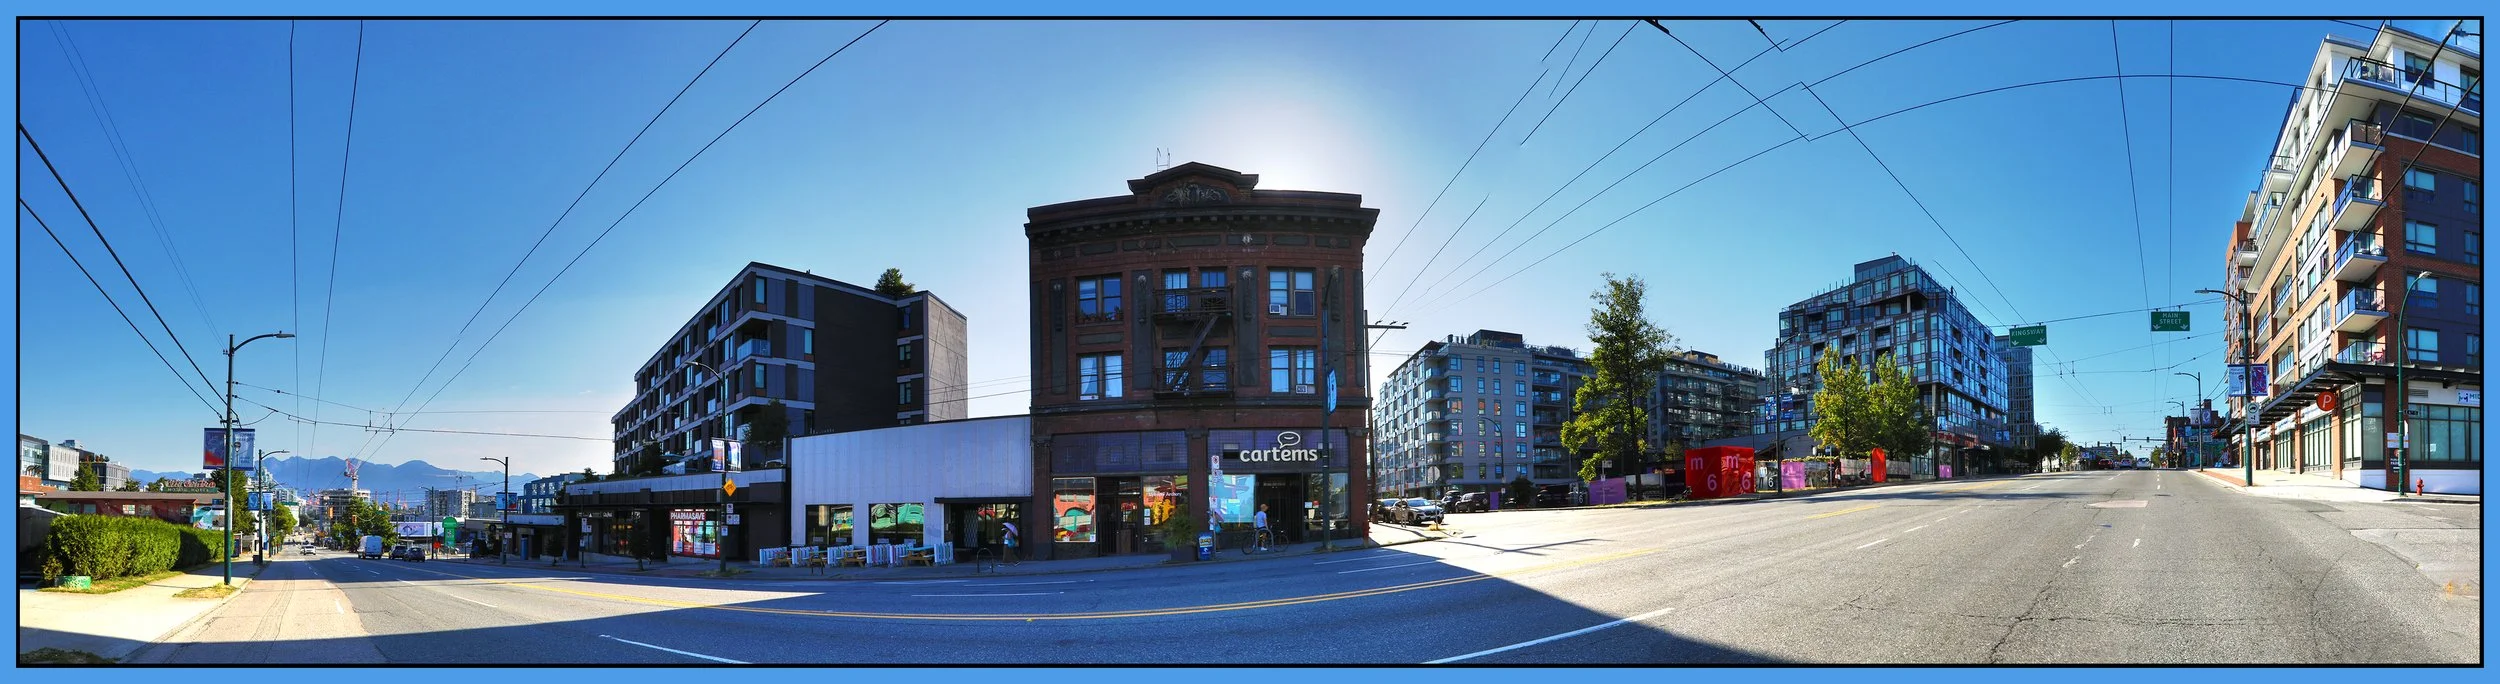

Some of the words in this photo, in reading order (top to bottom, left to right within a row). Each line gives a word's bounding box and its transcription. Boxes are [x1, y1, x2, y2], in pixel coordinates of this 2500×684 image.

[2322, 394, 2332, 408] P
[1240, 447, 1318, 462] cartems
[1690, 457, 1703, 470] m
[1726, 455, 1739, 469] m
[1707, 474, 1717, 491] 6
[1741, 471, 1751, 490] 6
[1768, 477, 1774, 488] 6
[670, 512, 705, 520] PHARMASAVE
